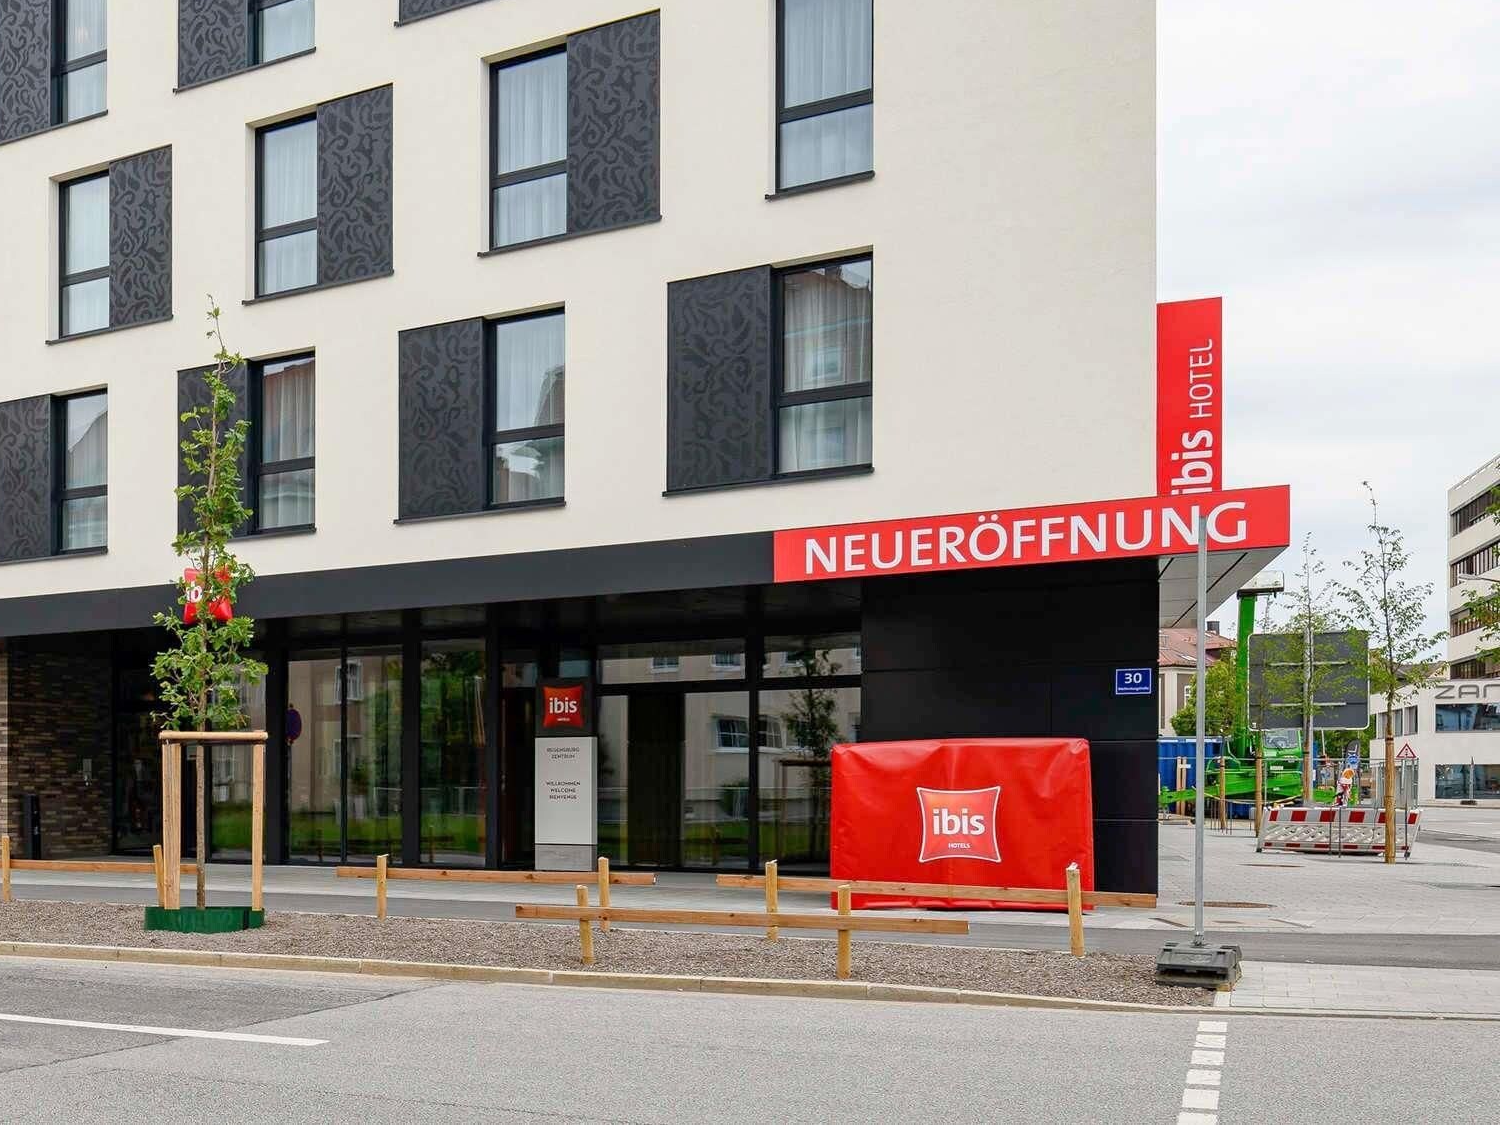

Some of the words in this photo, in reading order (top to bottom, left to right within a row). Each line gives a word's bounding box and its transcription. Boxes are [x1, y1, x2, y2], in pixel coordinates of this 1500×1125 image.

[1189, 338, 1213, 418] HOTEL
[1171, 429, 1213, 495] ibis
[805, 501, 1248, 574] NEUERÖFFNUNG
[1124, 672, 1143, 684] 30
[549, 697, 578, 714] ibis
[932, 808, 986, 835] ibis
